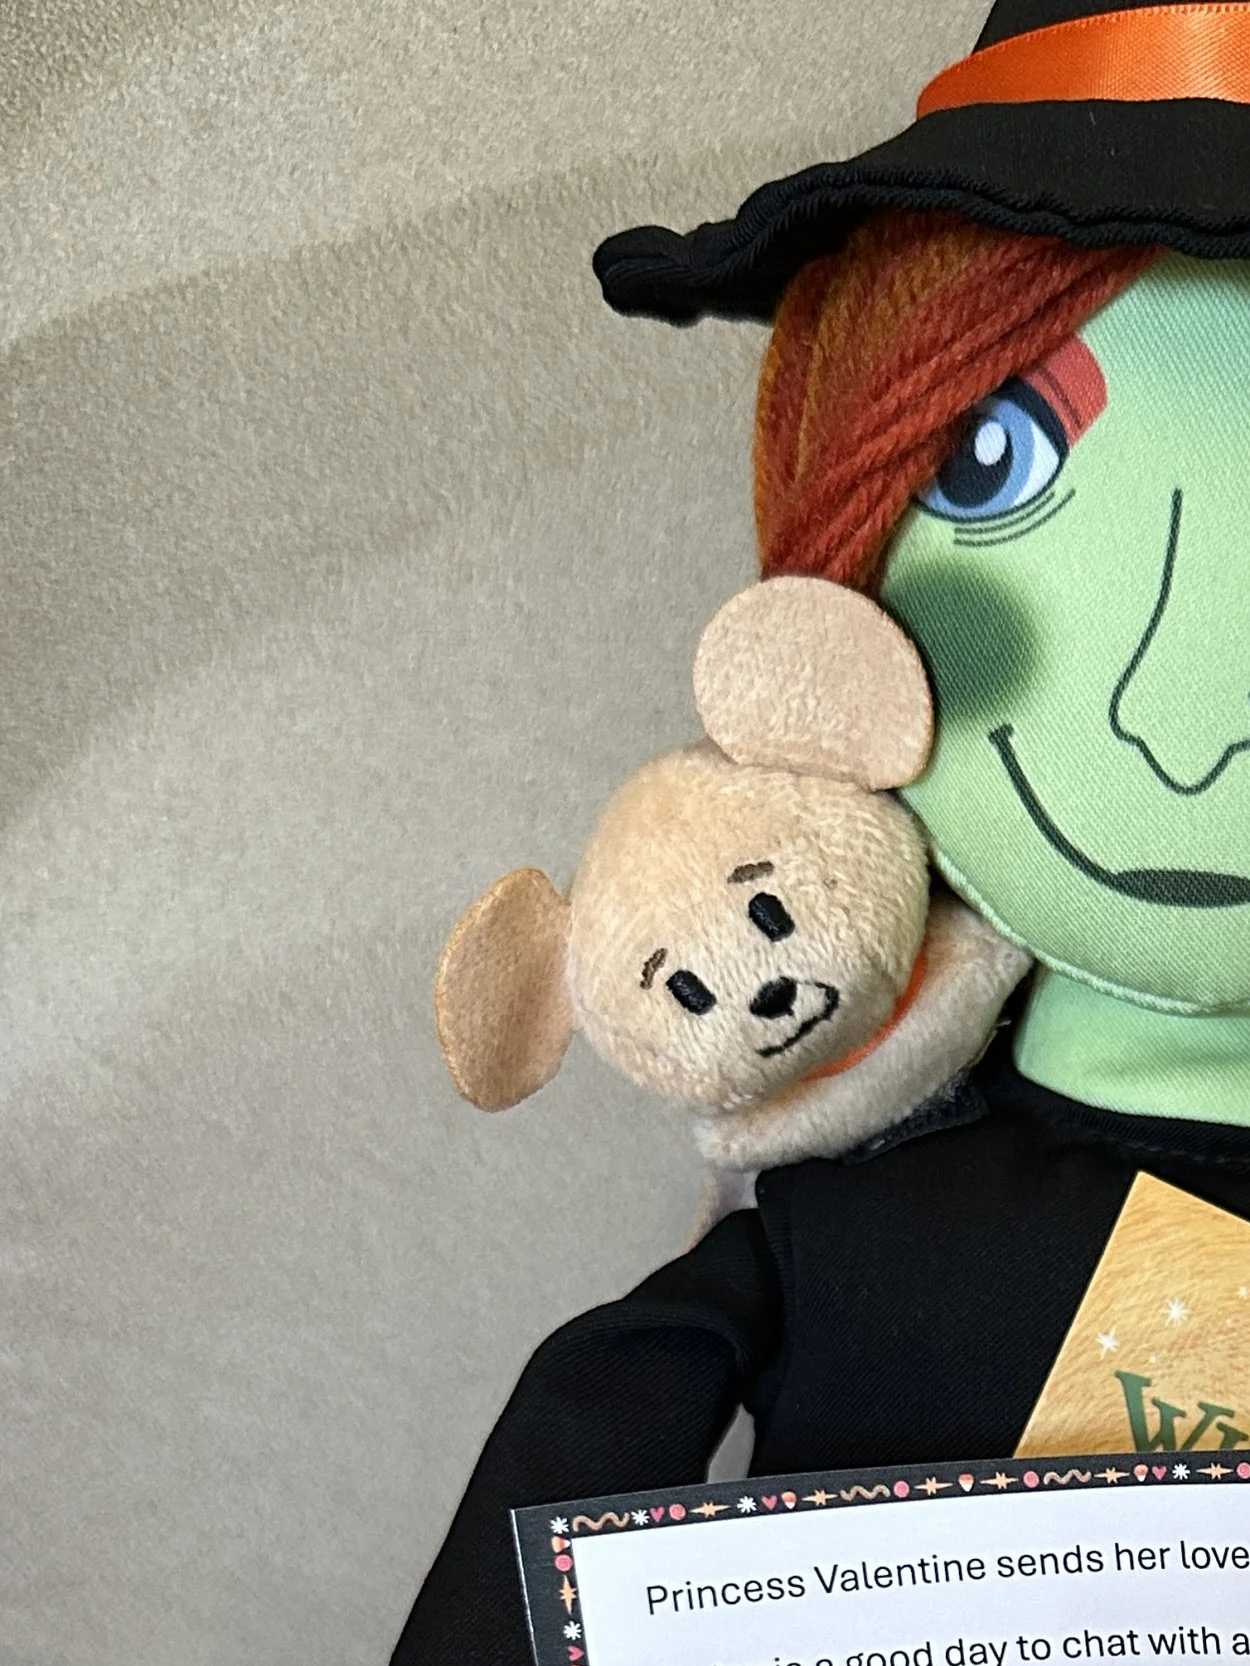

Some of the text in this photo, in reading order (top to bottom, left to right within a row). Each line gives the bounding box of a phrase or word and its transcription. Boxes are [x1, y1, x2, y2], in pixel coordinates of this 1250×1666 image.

[646, 1575, 806, 1616] Princess
[813, 1554, 986, 1594] Valentine
[997, 1544, 1104, 1578] sends
[1114, 1542, 1171, 1571] her
[1015, 1635, 1051, 1661] to
[1062, 1629, 1141, 1659] chat
[1147, 1626, 1221, 1656] with
[1232, 1632, 1250, 1656] a
